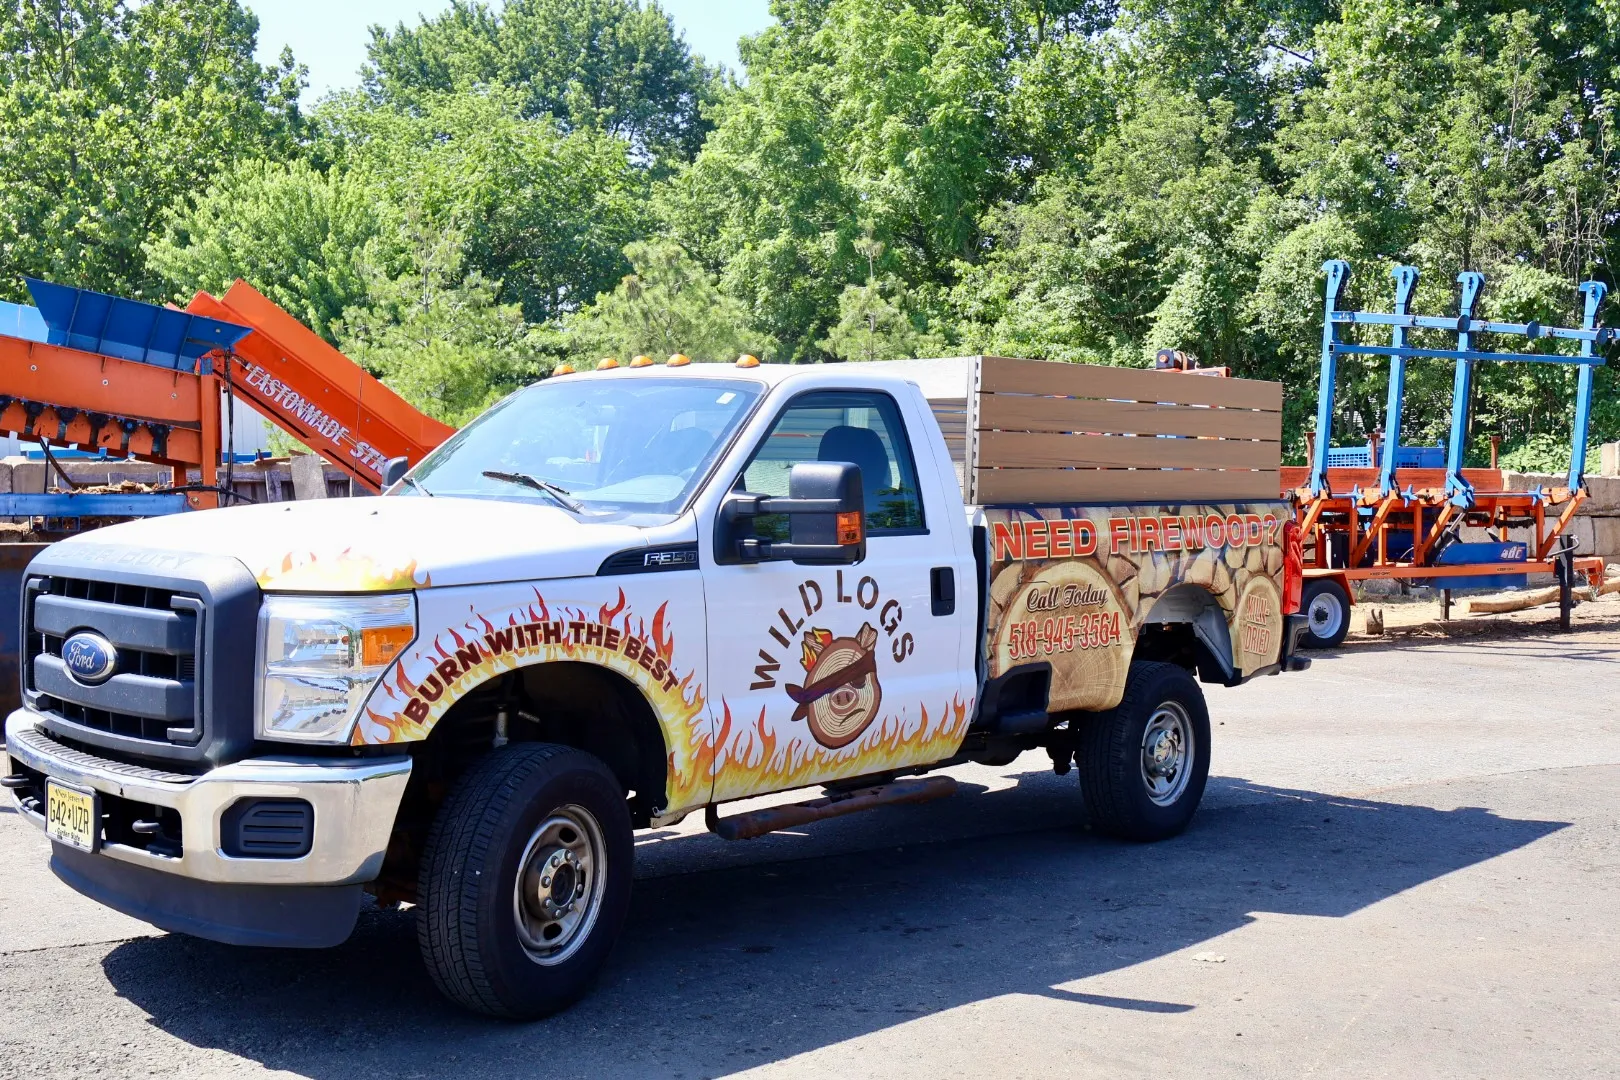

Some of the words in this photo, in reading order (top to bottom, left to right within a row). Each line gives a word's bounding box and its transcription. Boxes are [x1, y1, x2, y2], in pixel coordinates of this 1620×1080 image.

[245, 365, 350, 446] EASTONMADE
[993, 518, 1097, 561] NEED
[1108, 513, 1278, 555] FIREWOOD?
[1026, 586, 1060, 612] Call
[1064, 584, 1108, 608] Today
[749, 580, 823, 690] WILD
[836, 569, 914, 663] LOGS
[1009, 611, 1121, 659] 518-945-3564
[1244, 624, 1270, 656] DRIED
[68, 642, 95, 670] Ford
[402, 642, 484, 725] BURN
[483, 621, 562, 655] WITH
[569, 620, 621, 650] THE
[624, 635, 679, 694] BEST
[50, 797, 67, 827] G42
[72, 804, 89, 835] UZR
